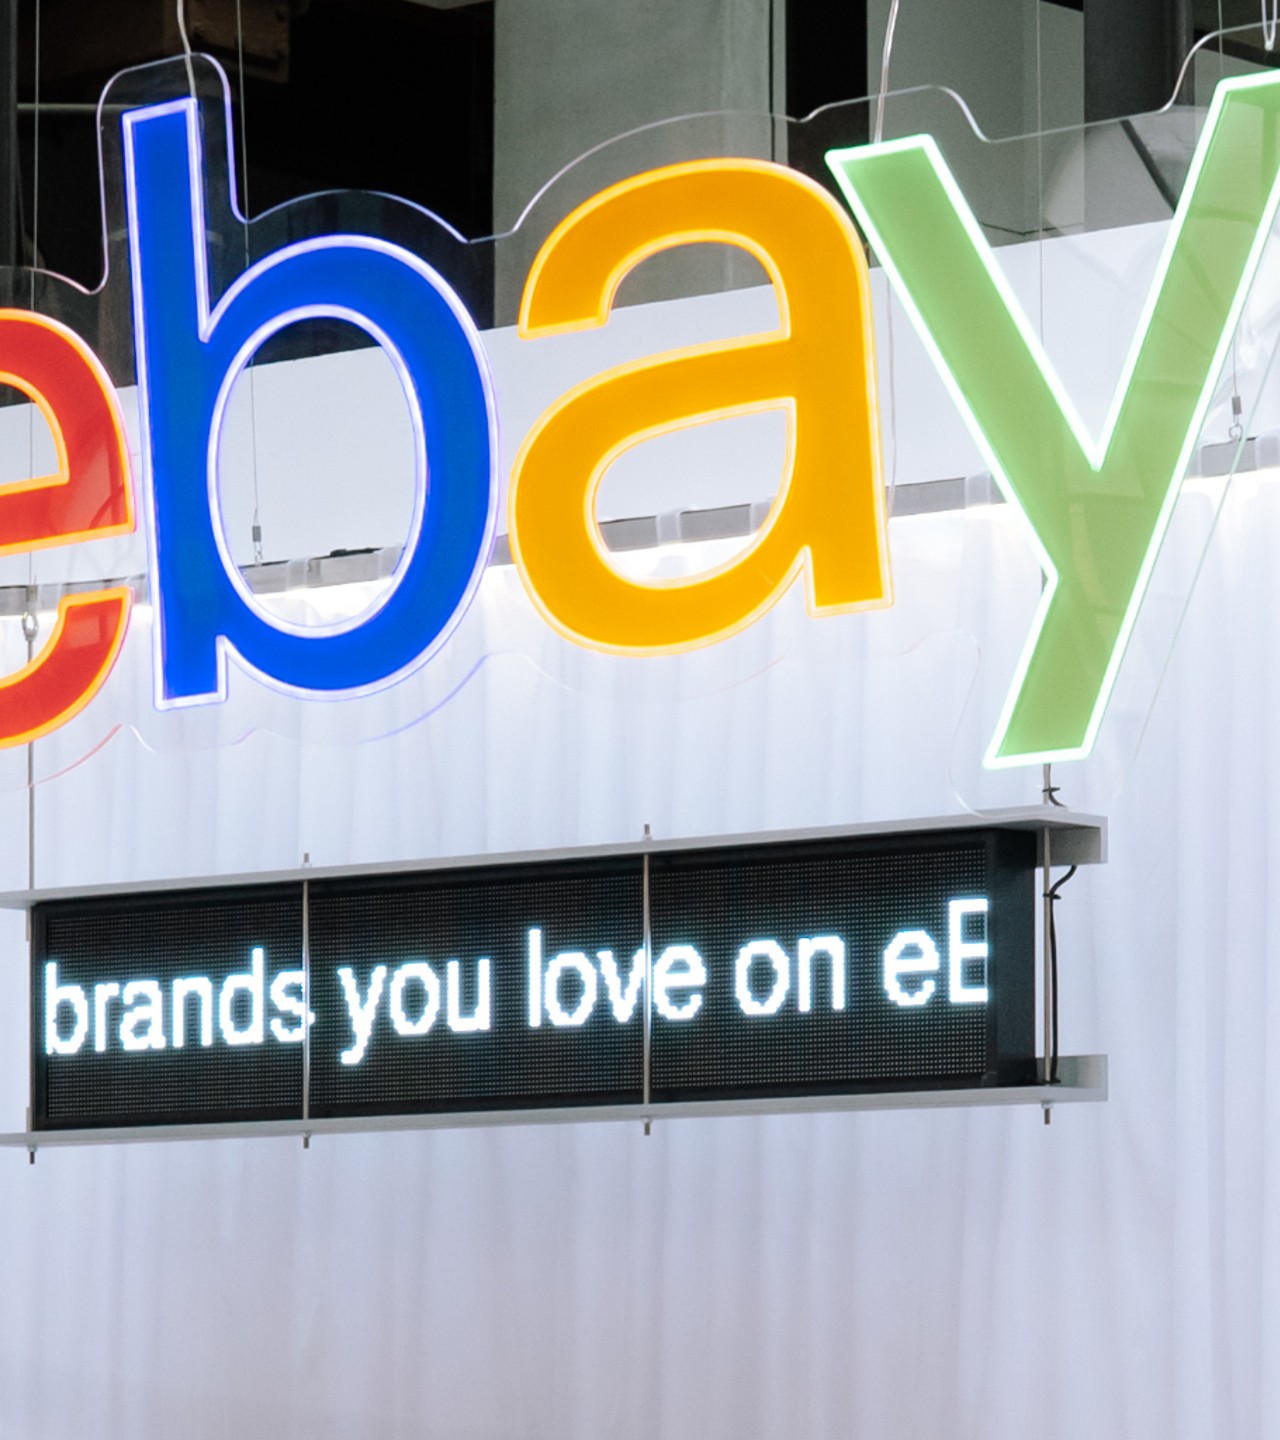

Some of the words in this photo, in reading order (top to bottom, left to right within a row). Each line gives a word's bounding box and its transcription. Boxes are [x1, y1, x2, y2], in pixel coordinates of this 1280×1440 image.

[43, 945, 316, 1057] brands
[336, 956, 492, 1065] you
[527, 927, 708, 1030] love
[733, 934, 847, 1016] on
